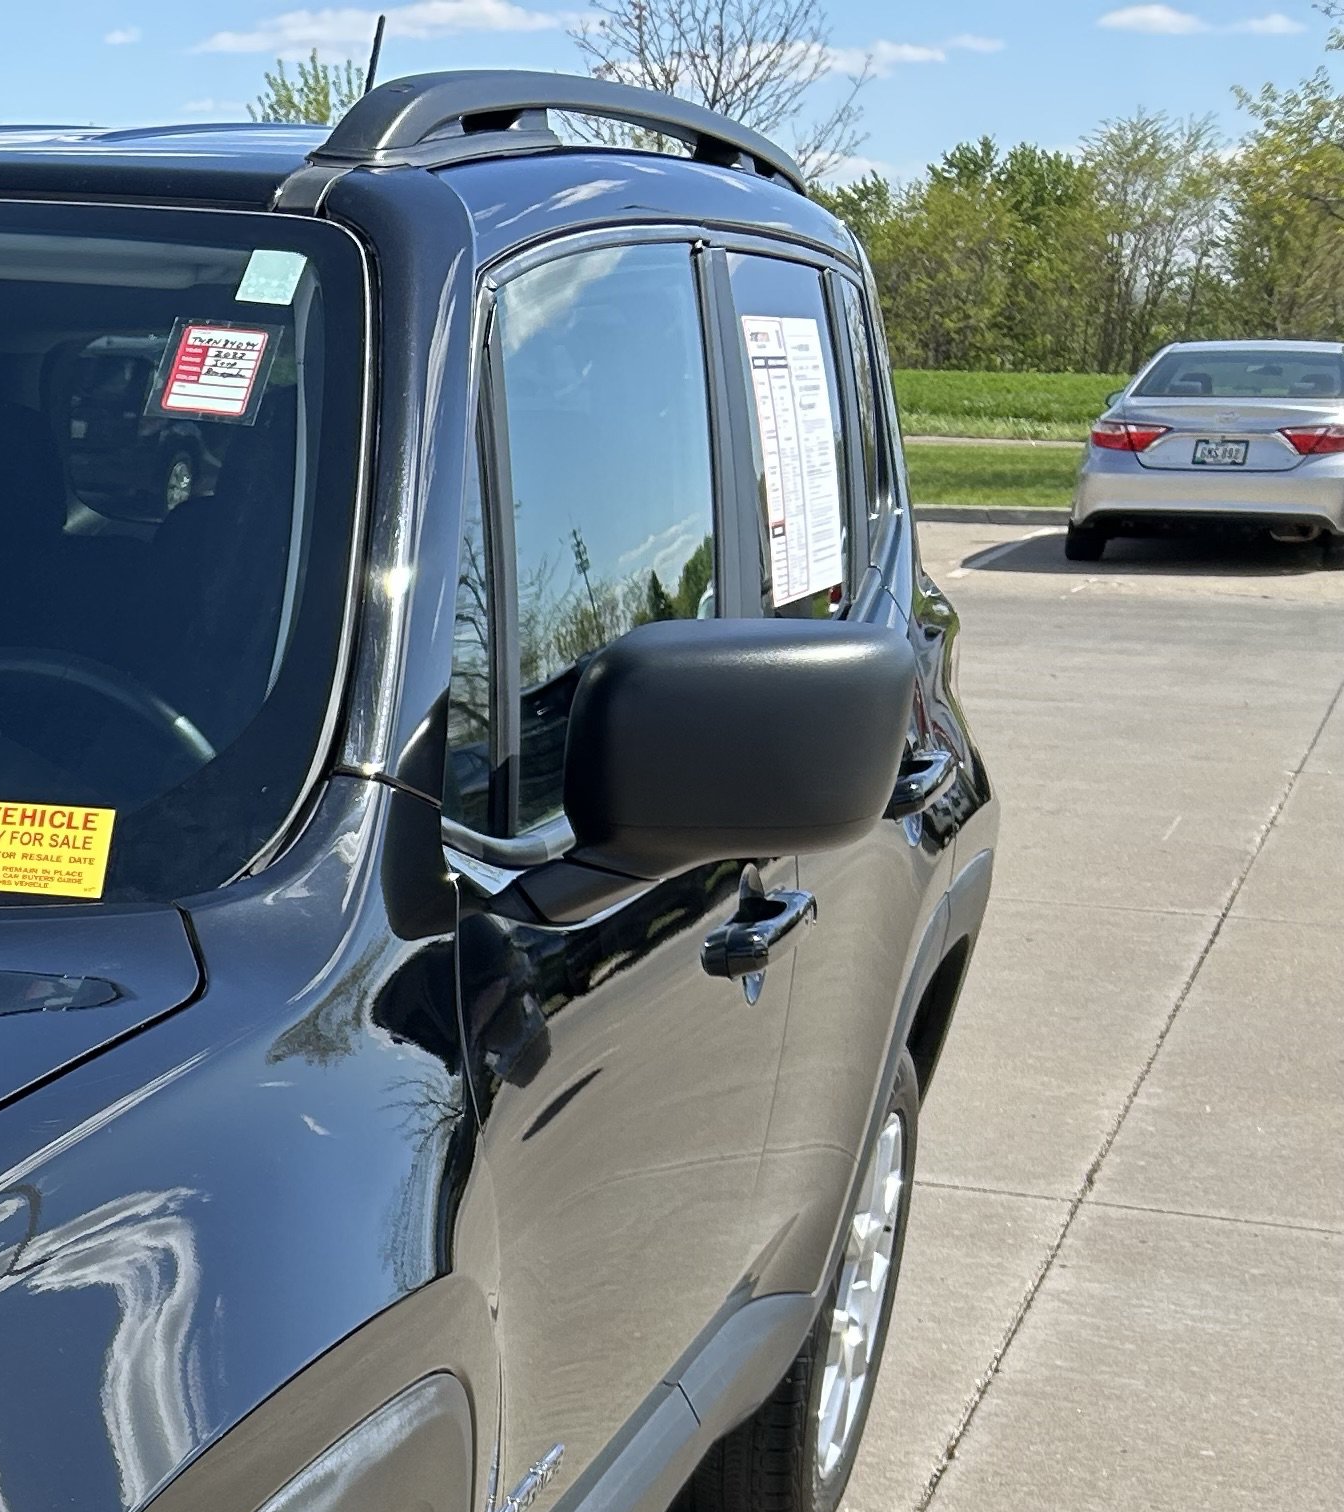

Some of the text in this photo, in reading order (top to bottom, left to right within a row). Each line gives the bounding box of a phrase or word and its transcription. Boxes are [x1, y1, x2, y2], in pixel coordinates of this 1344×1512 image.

[10, 831, 44, 847] FOR
[49, 833, 94, 850] SALE
[21, 853, 63, 862] RESALE
[69, 856, 96, 865] DATE
[2, 866, 38, 874] REMAIN
